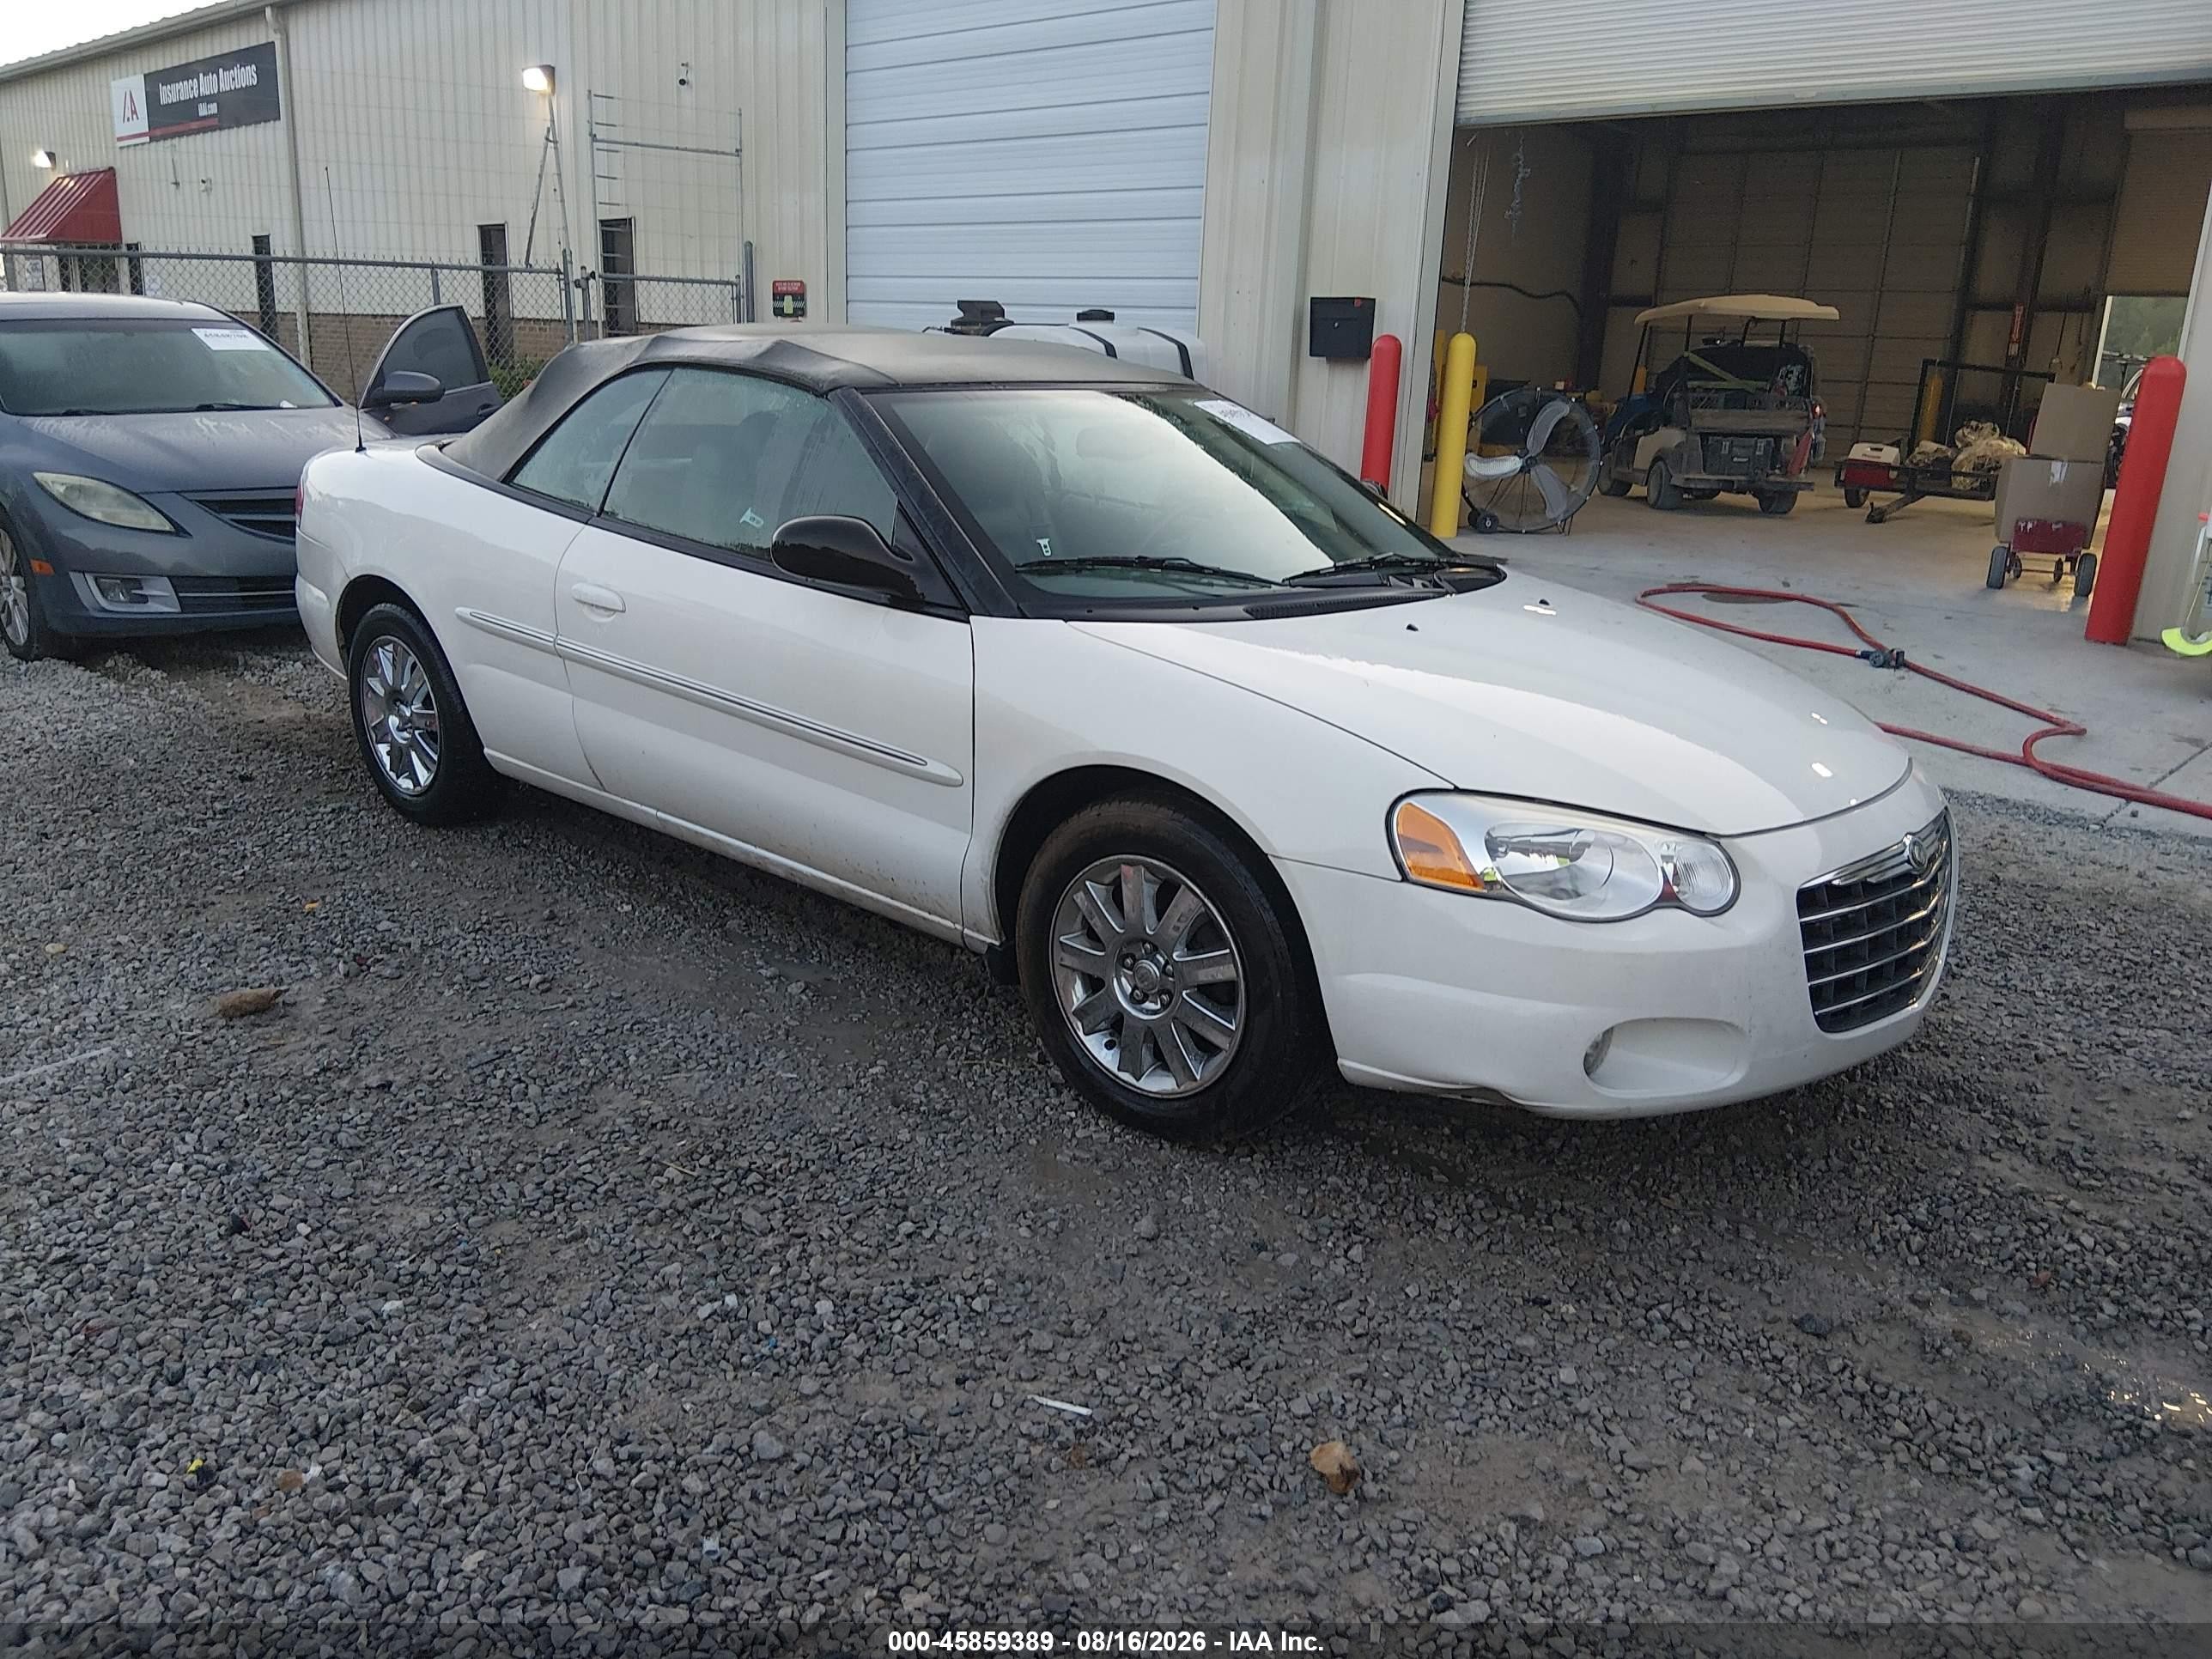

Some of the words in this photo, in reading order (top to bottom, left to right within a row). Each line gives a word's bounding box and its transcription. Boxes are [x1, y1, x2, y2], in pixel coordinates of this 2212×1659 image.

[159, 77, 199, 106] Insurance
[199, 72, 219, 97] Auto
[218, 64, 258, 93] Auctions
